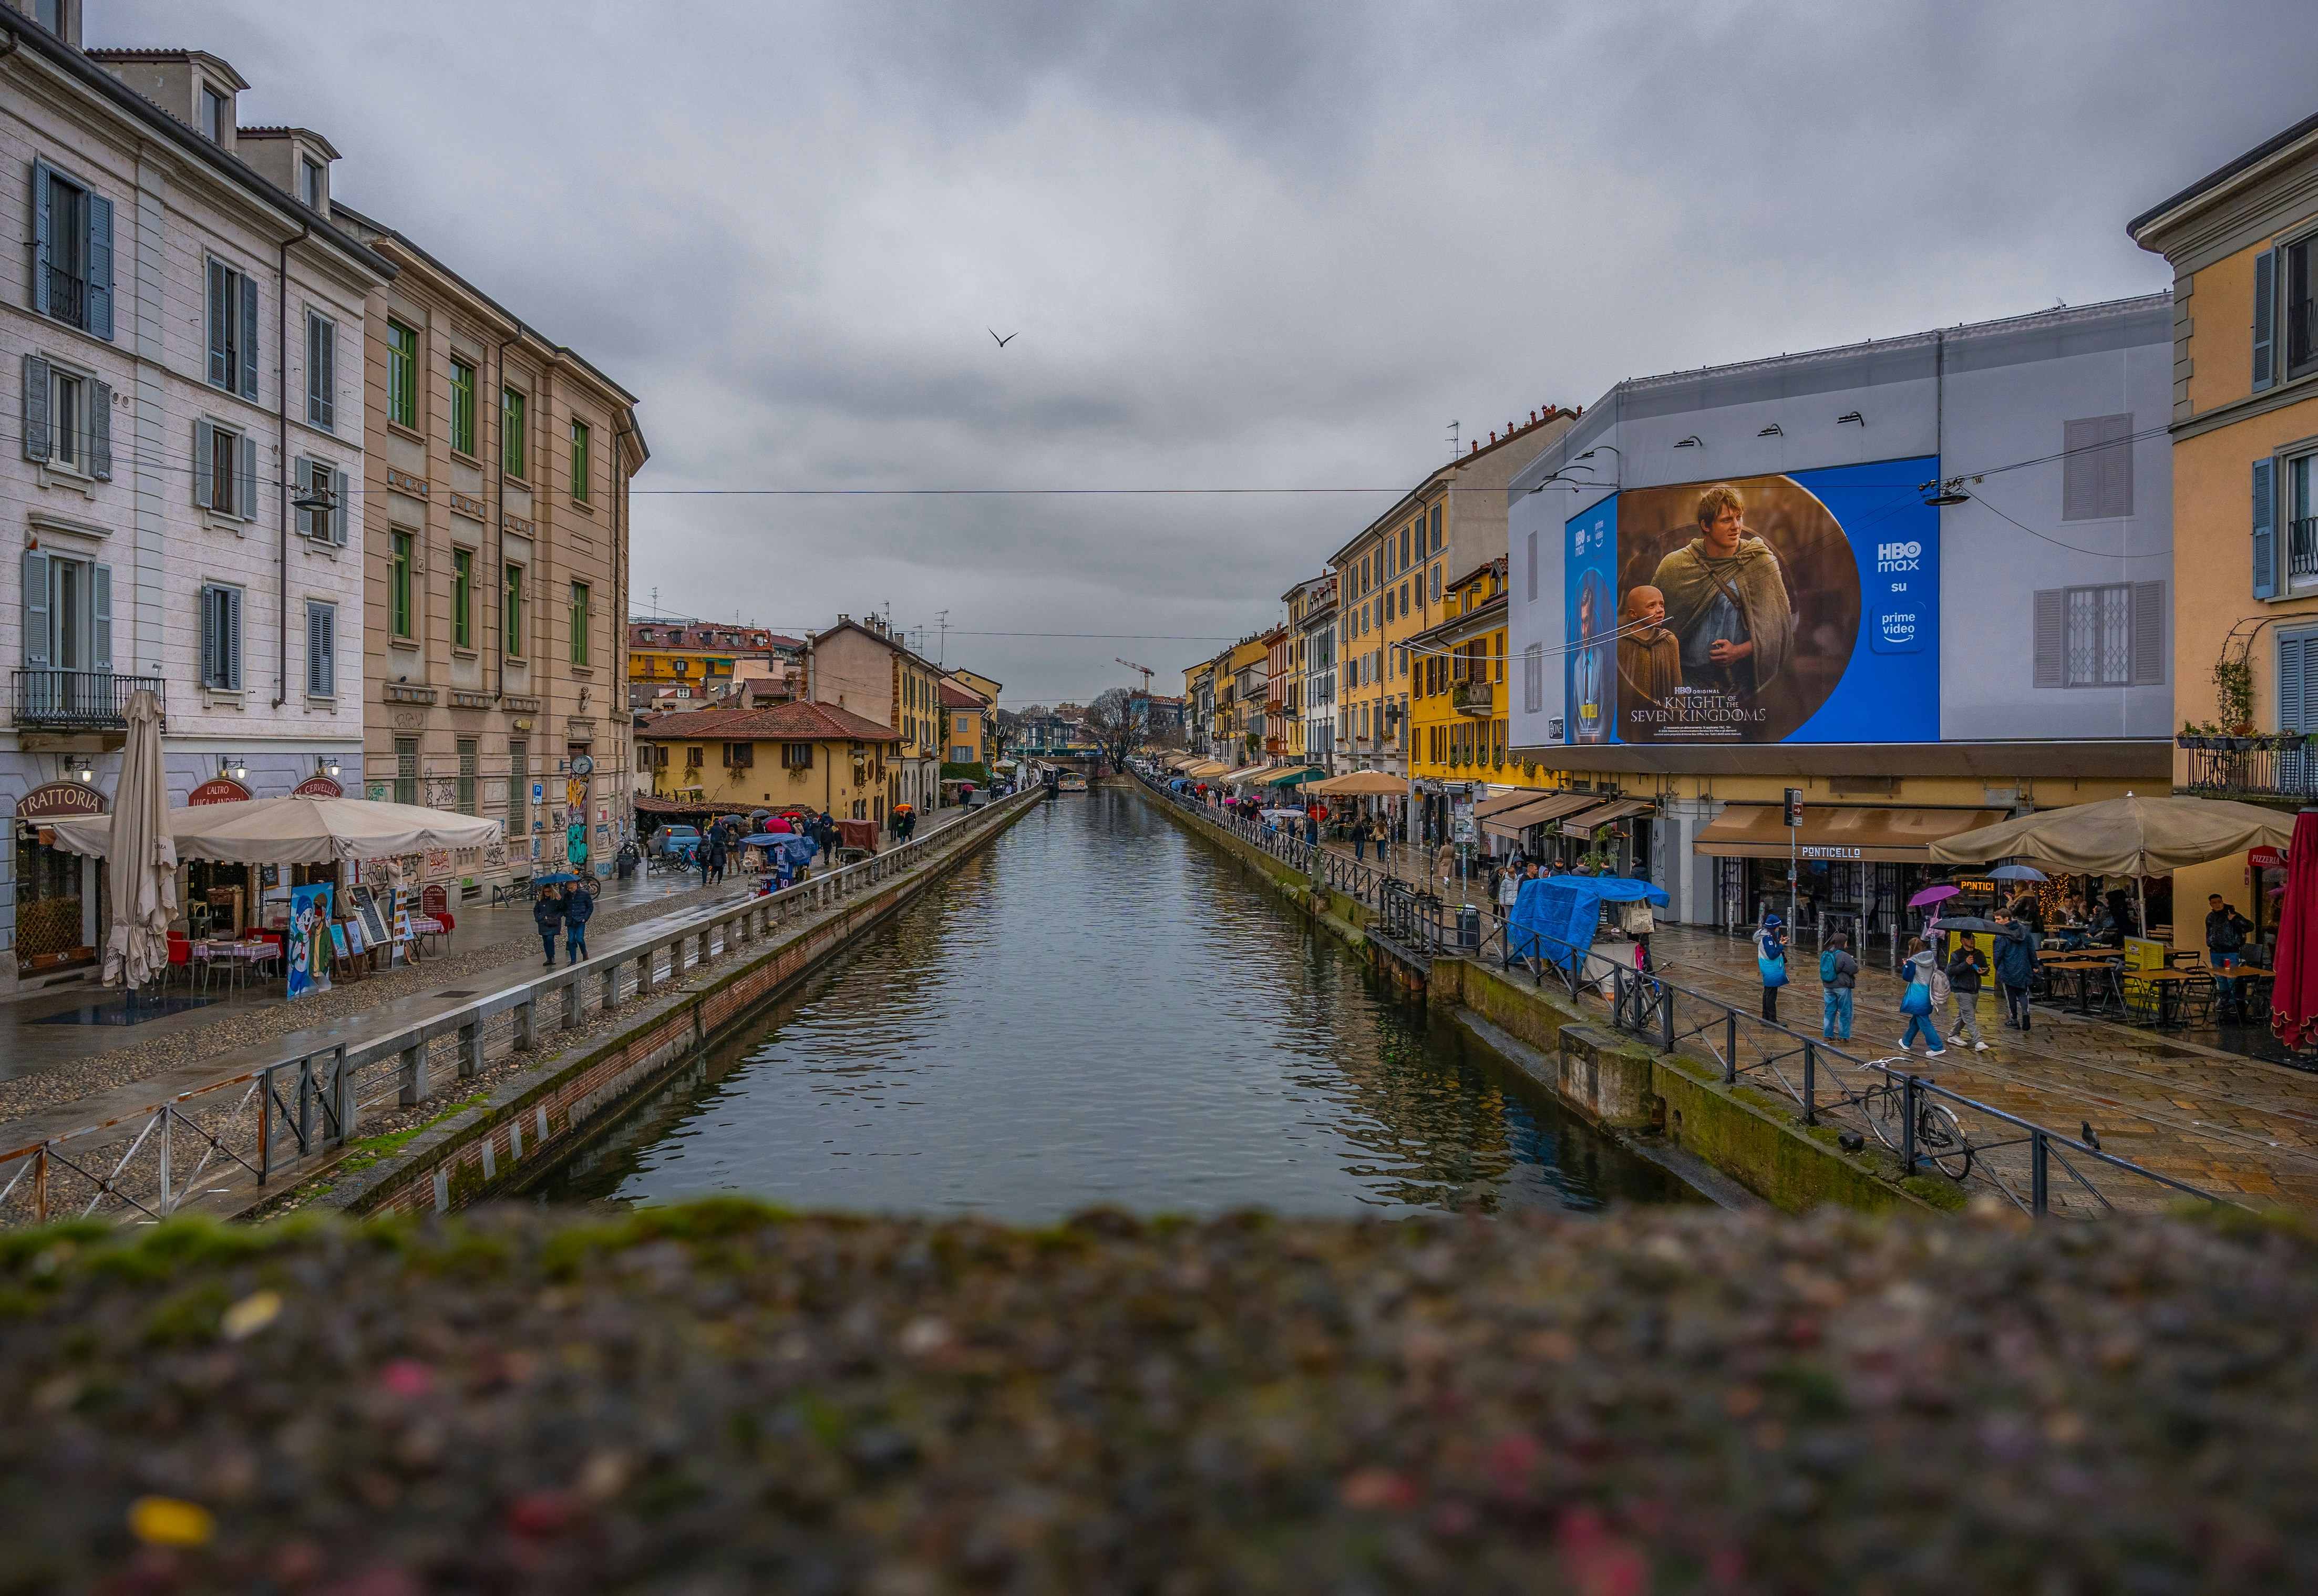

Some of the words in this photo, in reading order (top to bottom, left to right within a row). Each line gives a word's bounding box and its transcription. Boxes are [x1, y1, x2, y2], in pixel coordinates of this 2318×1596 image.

[1575, 529, 1585, 547] HBO
[1586, 534, 1591, 543] su
[1575, 544, 1584, 557] max
[1878, 541, 1921, 560] HBO
[1878, 559, 1919, 572] max
[1891, 583, 1907, 592] su
[1882, 612, 1915, 625] prime
[1883, 624, 1915, 634] video
[1665, 696, 1725, 708] KNIGHT
[1631, 710, 1673, 722] SEVEN
[1680, 708, 1766, 722] KINGDOMS
[1553, 723, 1562, 734] ONE
[207, 786, 229, 795] L'ALTRO
[305, 784, 337, 797] CERVELLÈE
[18, 789, 98, 817] TRATTORIA
[1802, 847, 1860, 858] PONTICELLO
[2252, 854, 2280, 864] PIZZERIA
[780, 878, 788, 888] 10
